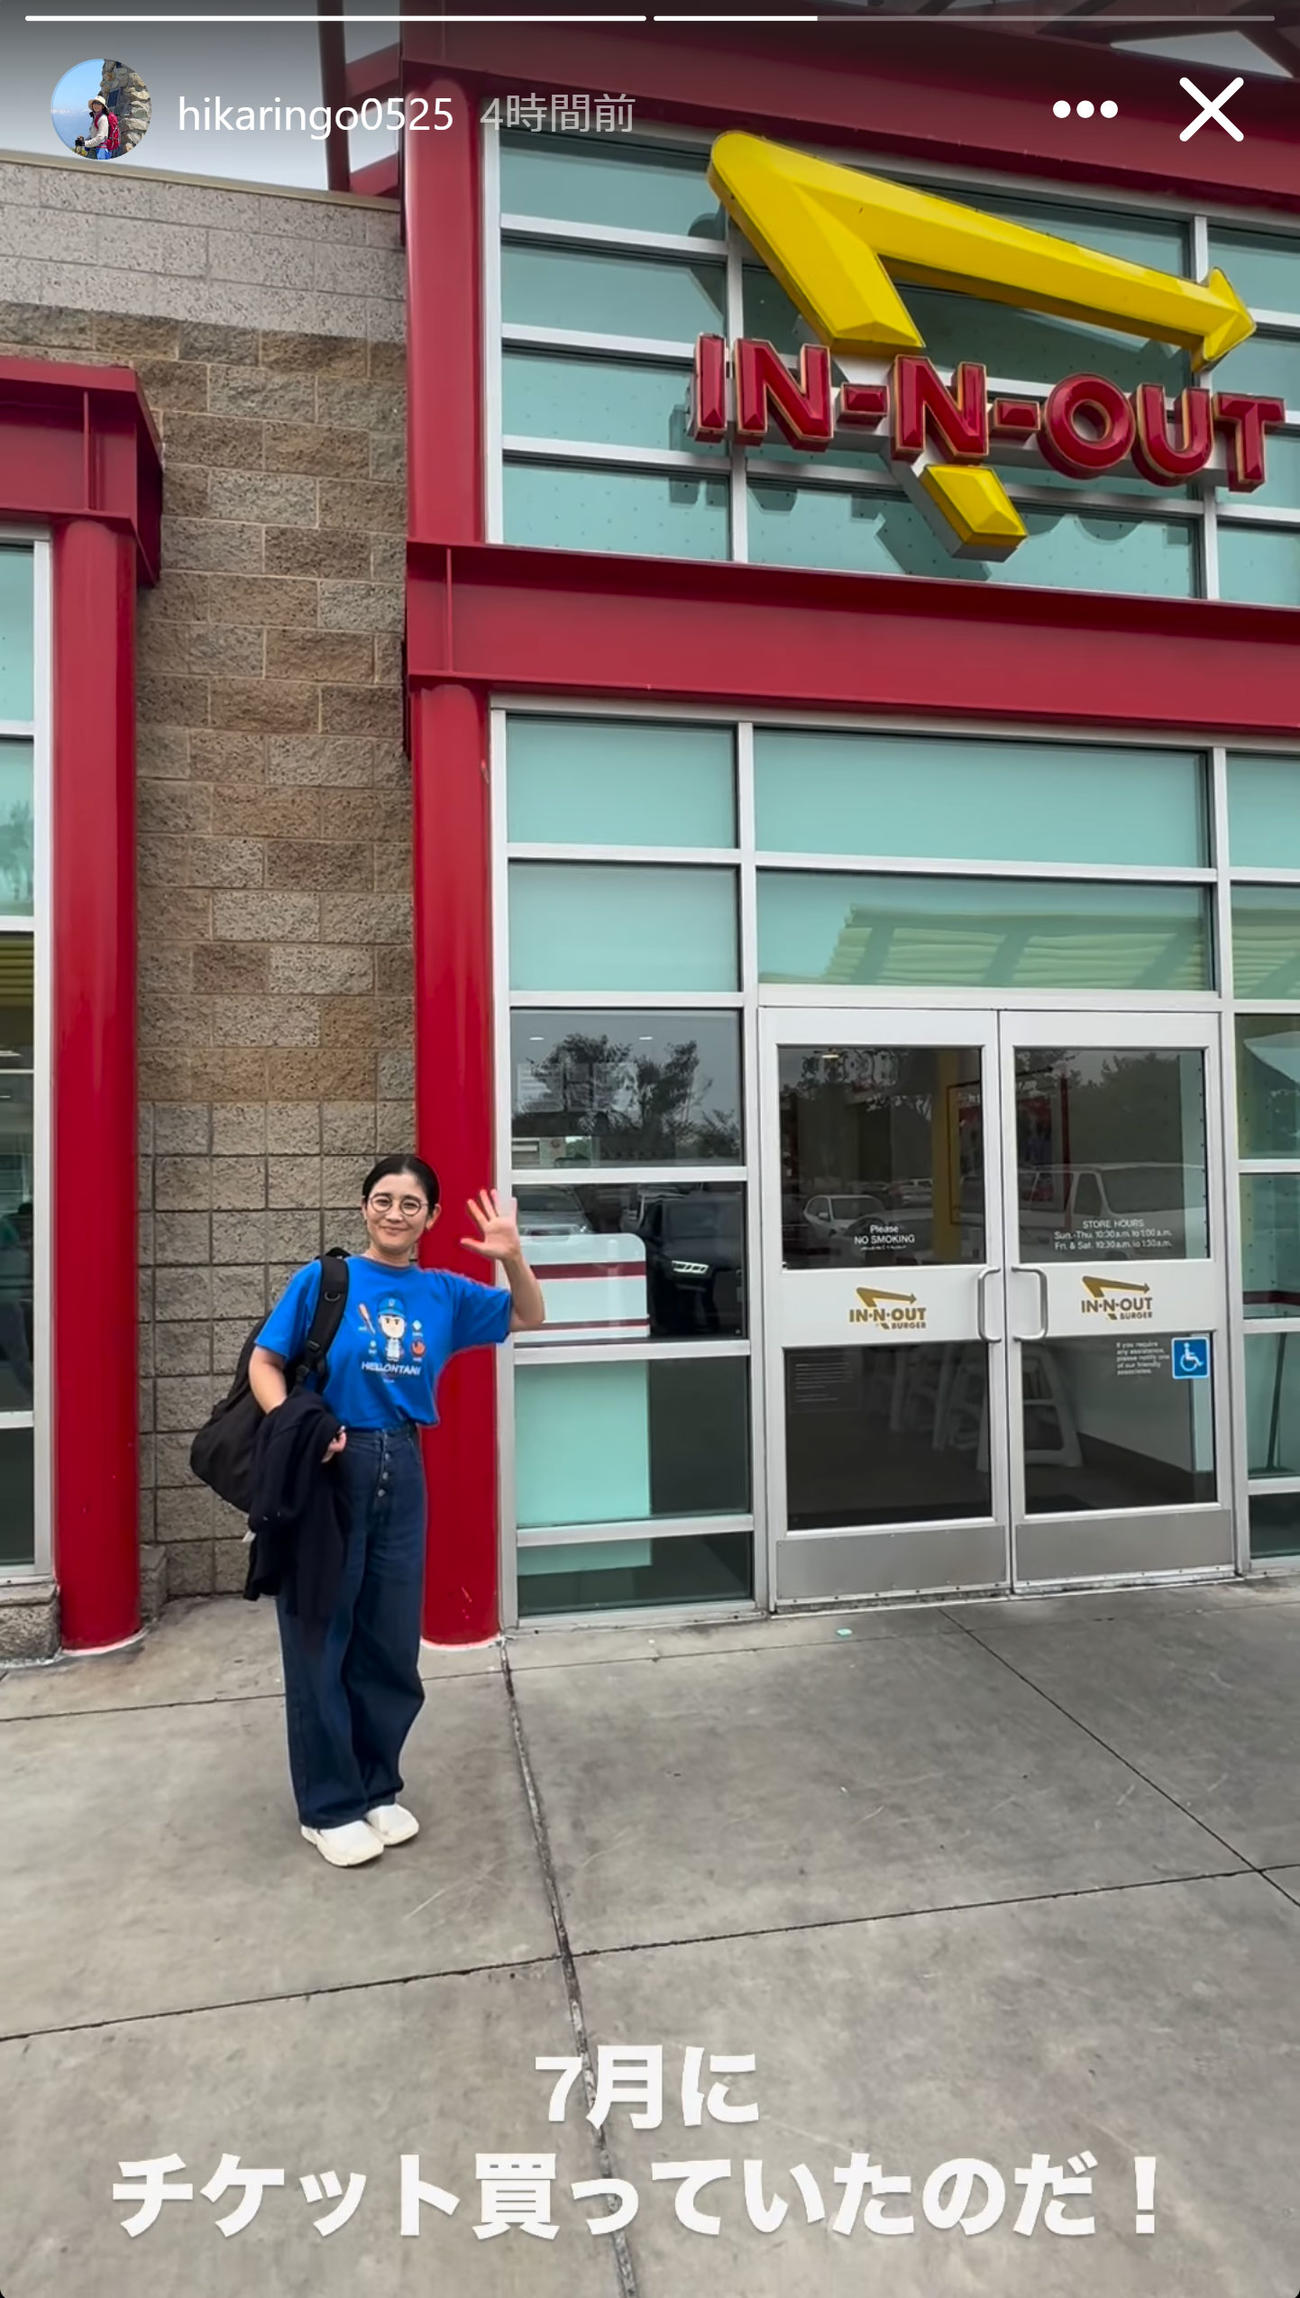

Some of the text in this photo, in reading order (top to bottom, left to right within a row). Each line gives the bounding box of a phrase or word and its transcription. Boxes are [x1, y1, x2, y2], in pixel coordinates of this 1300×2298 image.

[690, 333, 1286, 493] IN-N-OUT
[1082, 1218, 1144, 1229] STORE HOURS
[870, 1224, 899, 1234] Please
[854, 1233, 915, 1245] NO SMOKING
[1120, 1311, 1153, 1320] BURGER
[891, 1321, 926, 1330] BURGER
